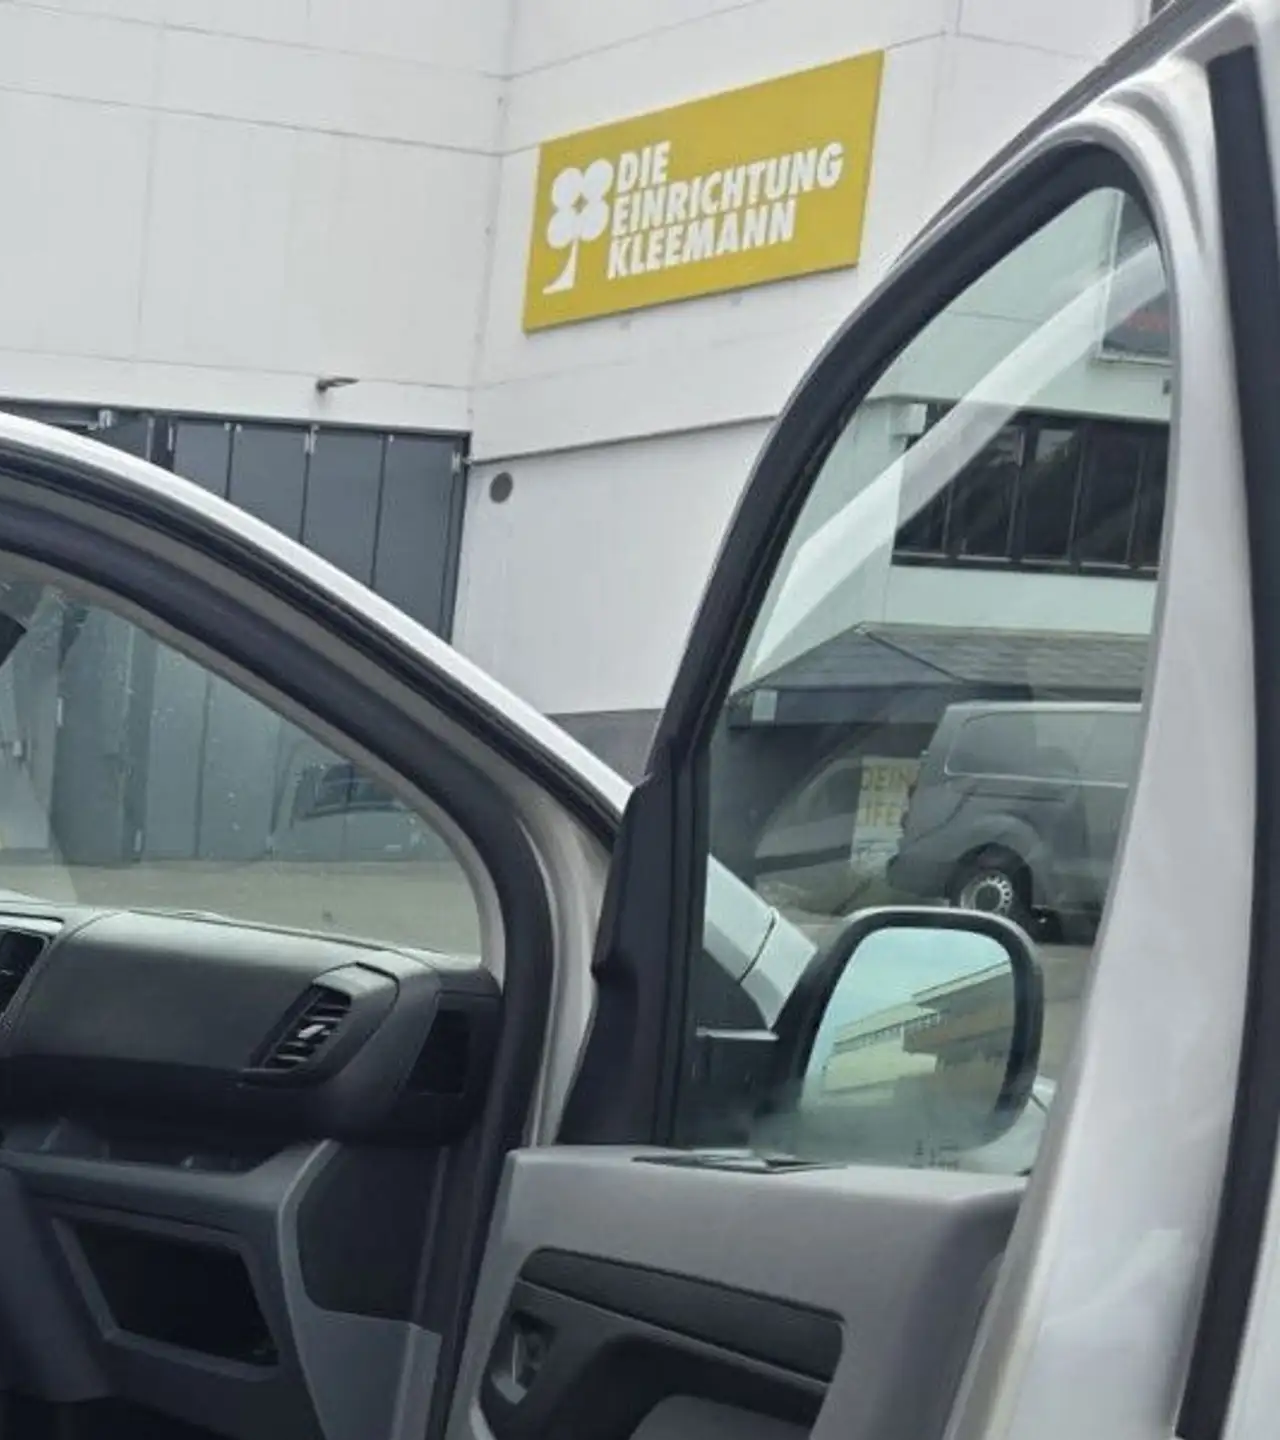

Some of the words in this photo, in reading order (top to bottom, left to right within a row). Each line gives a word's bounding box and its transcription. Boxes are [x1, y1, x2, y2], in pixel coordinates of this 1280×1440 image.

[611, 142, 843, 236] EINRICHTUNG
[617, 140, 671, 194] DIE
[608, 201, 795, 279] KLEEMANN
